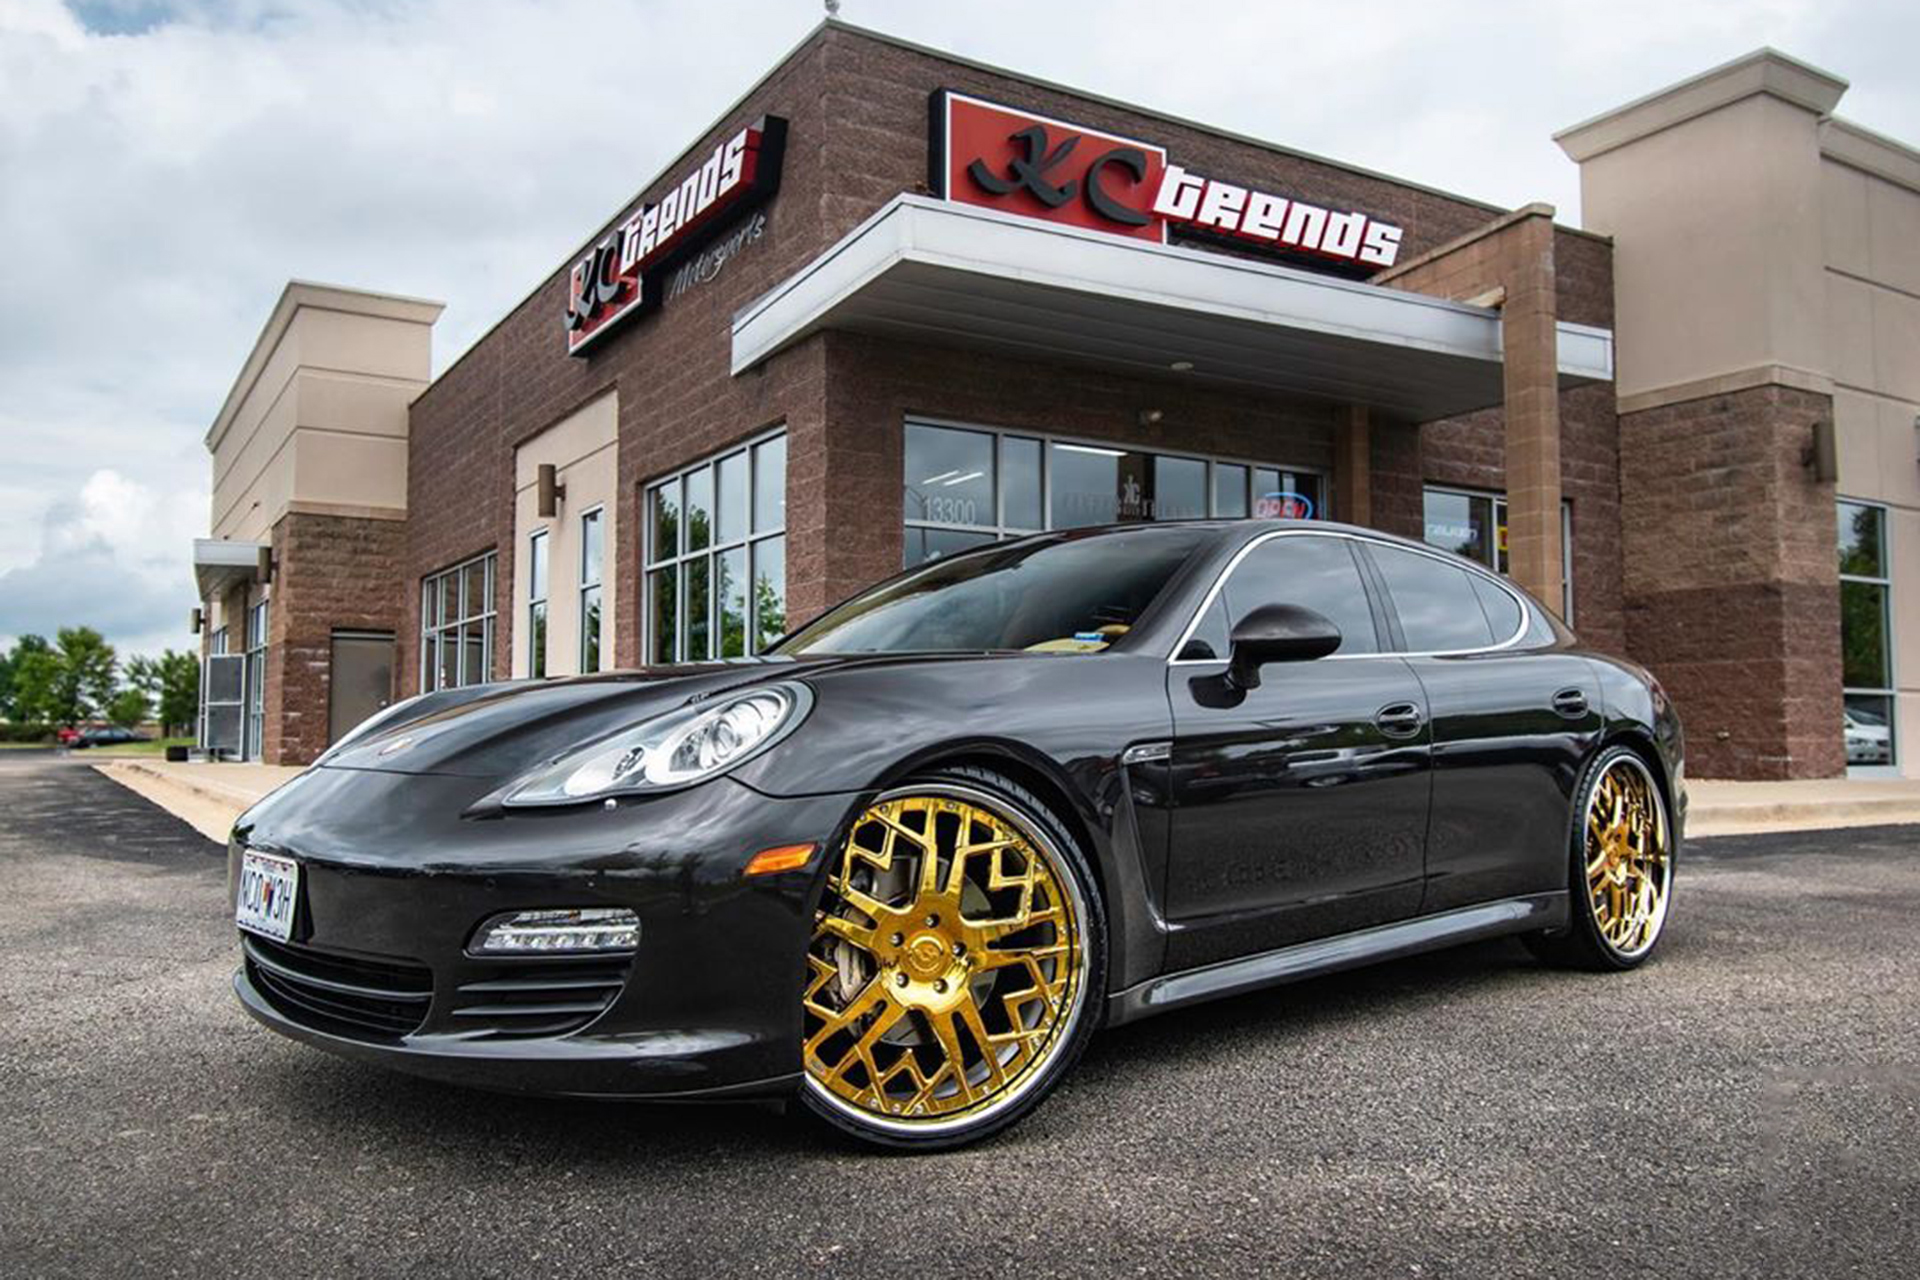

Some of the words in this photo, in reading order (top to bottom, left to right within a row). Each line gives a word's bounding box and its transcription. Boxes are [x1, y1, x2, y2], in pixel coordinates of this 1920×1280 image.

[967, 123, 1152, 227] KC
[669, 212, 766, 301] Motorsports
[922, 496, 976, 526] 13300
[1256, 498, 1306, 519] OPEN
